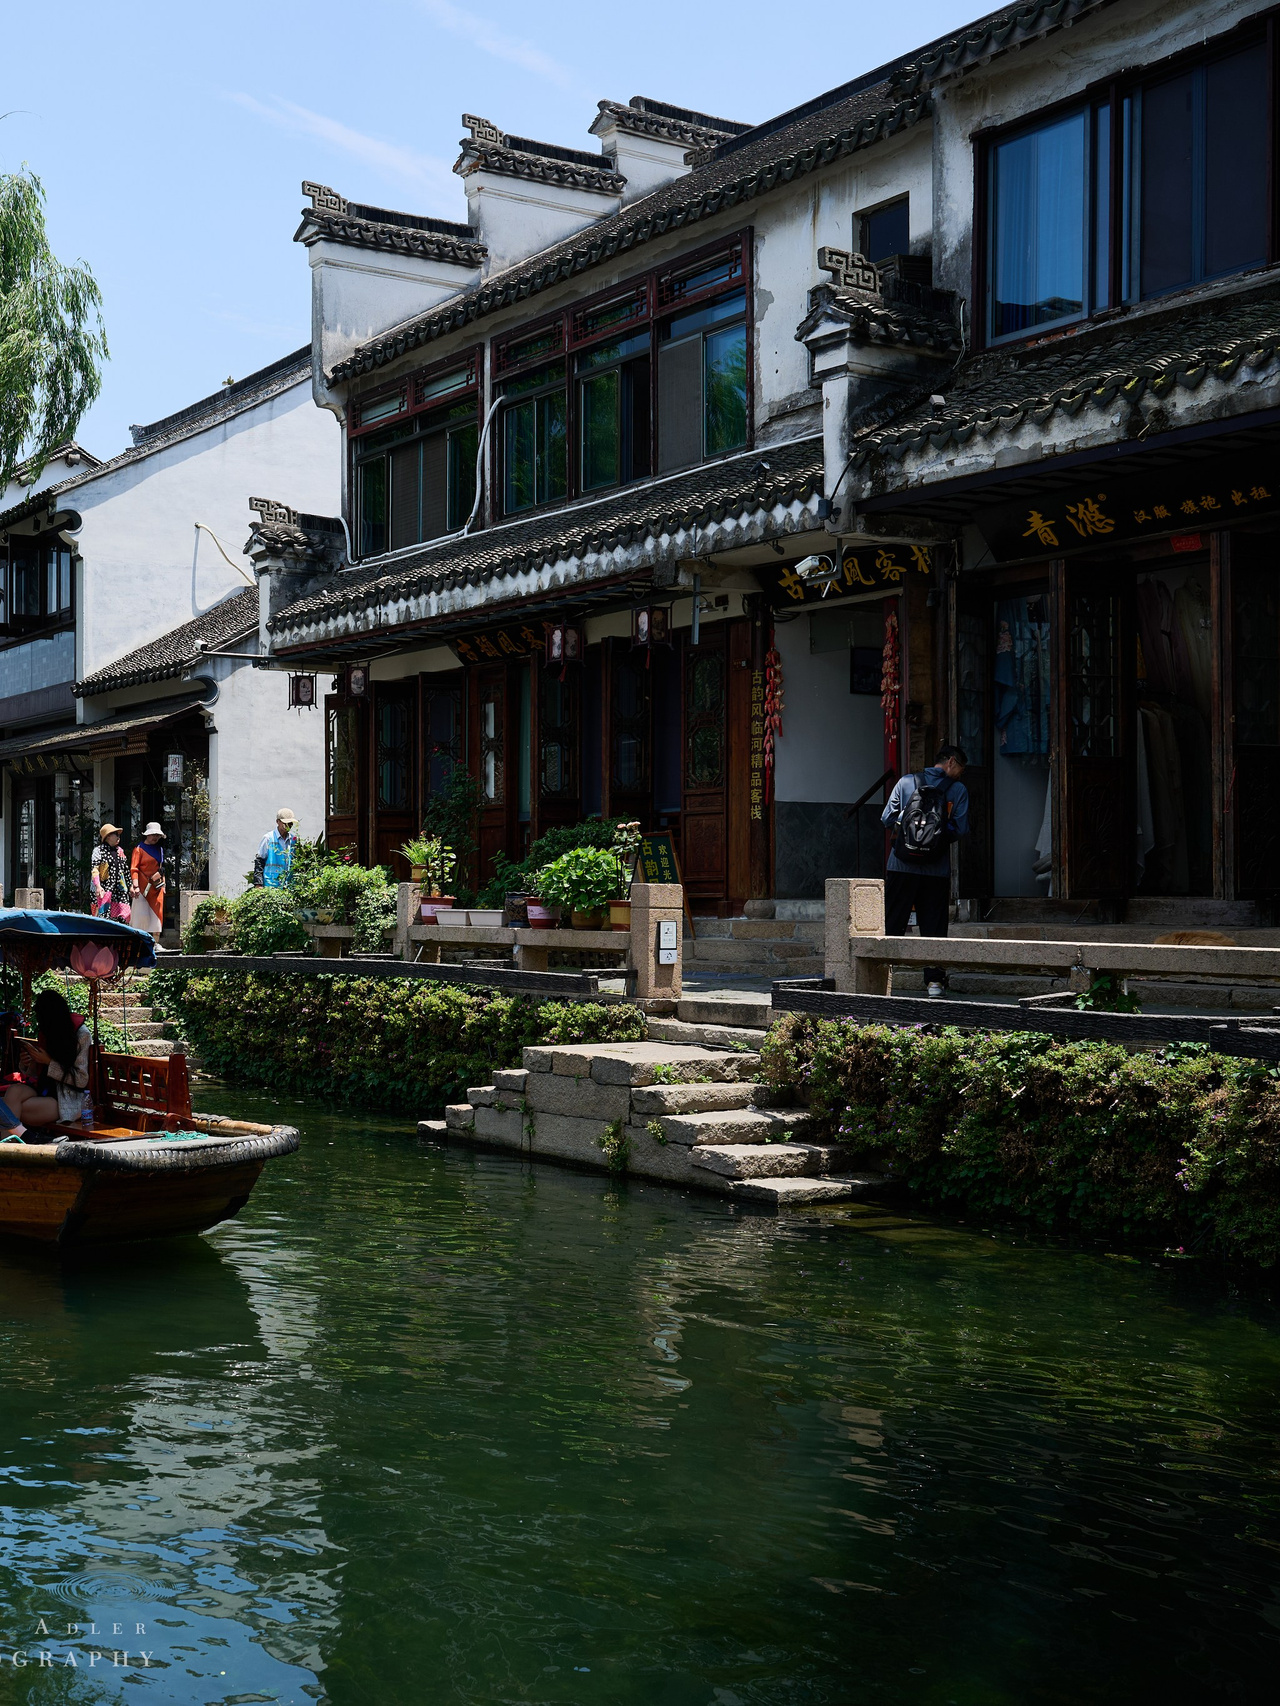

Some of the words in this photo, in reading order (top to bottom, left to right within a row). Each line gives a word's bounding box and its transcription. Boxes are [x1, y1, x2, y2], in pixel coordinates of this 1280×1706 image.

[1179, 494, 1222, 515] 旗袍
[1230, 485, 1272, 506] 出租
[750, 669, 764, 820] 古韵风临河精品客栈
[658, 844, 672, 884] 欢迎光
